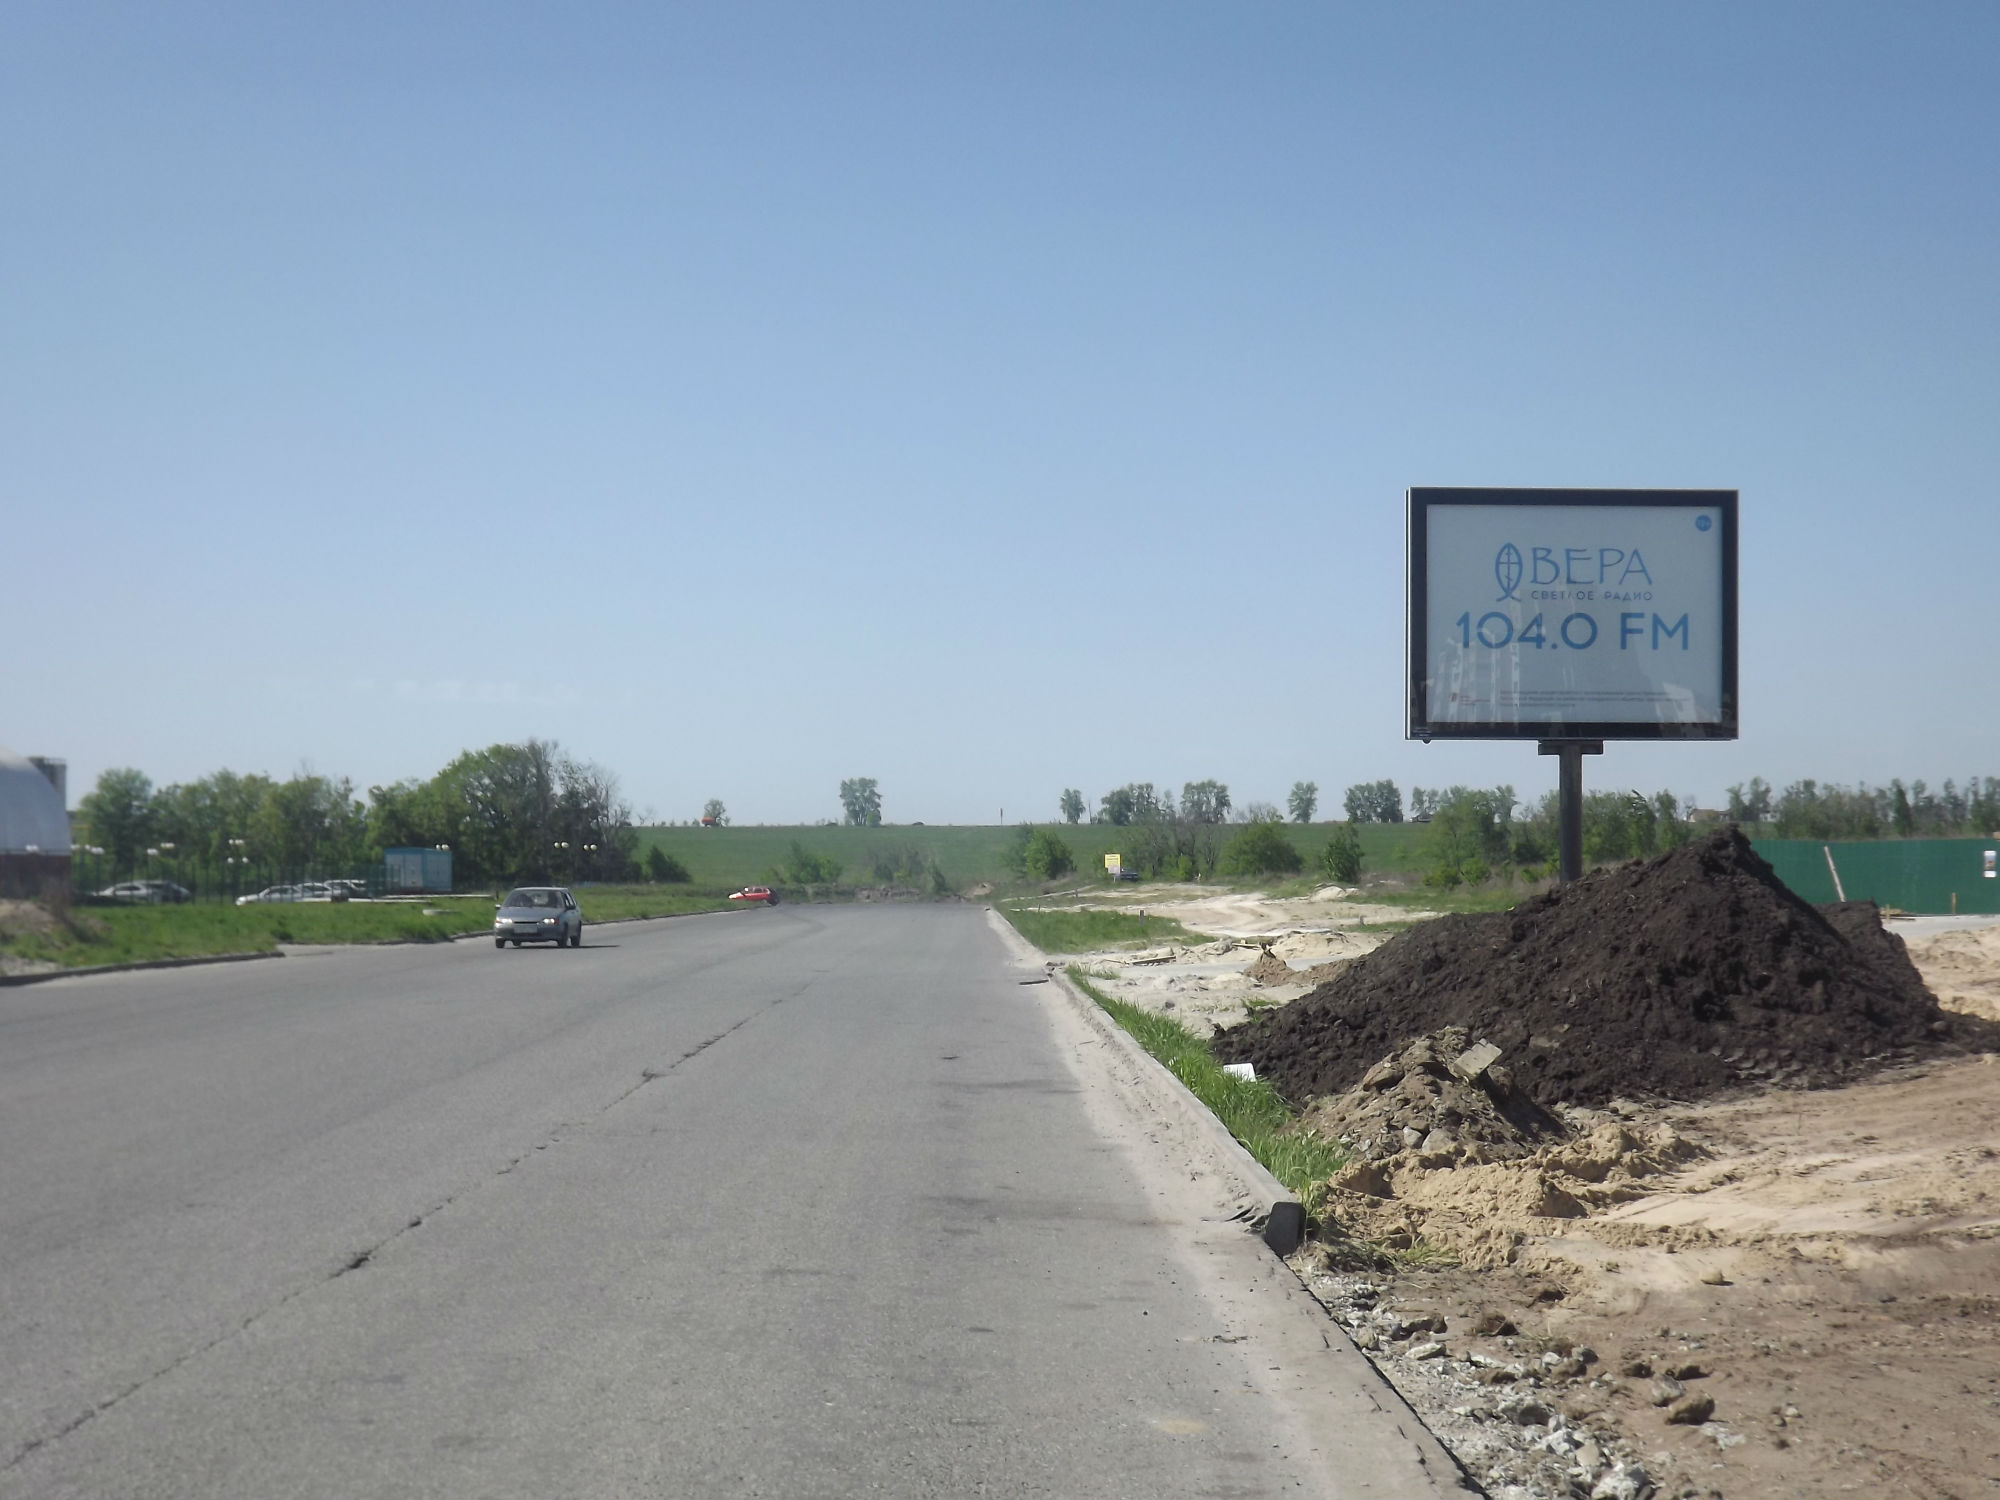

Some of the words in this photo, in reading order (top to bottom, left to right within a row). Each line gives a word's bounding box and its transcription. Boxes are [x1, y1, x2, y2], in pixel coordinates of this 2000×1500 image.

[1530, 547, 1652, 585] ВЕРА
[1604, 591, 1653, 602] РАДИО
[1456, 611, 1598, 650] 104.0
[1620, 612, 1689, 651] FM
